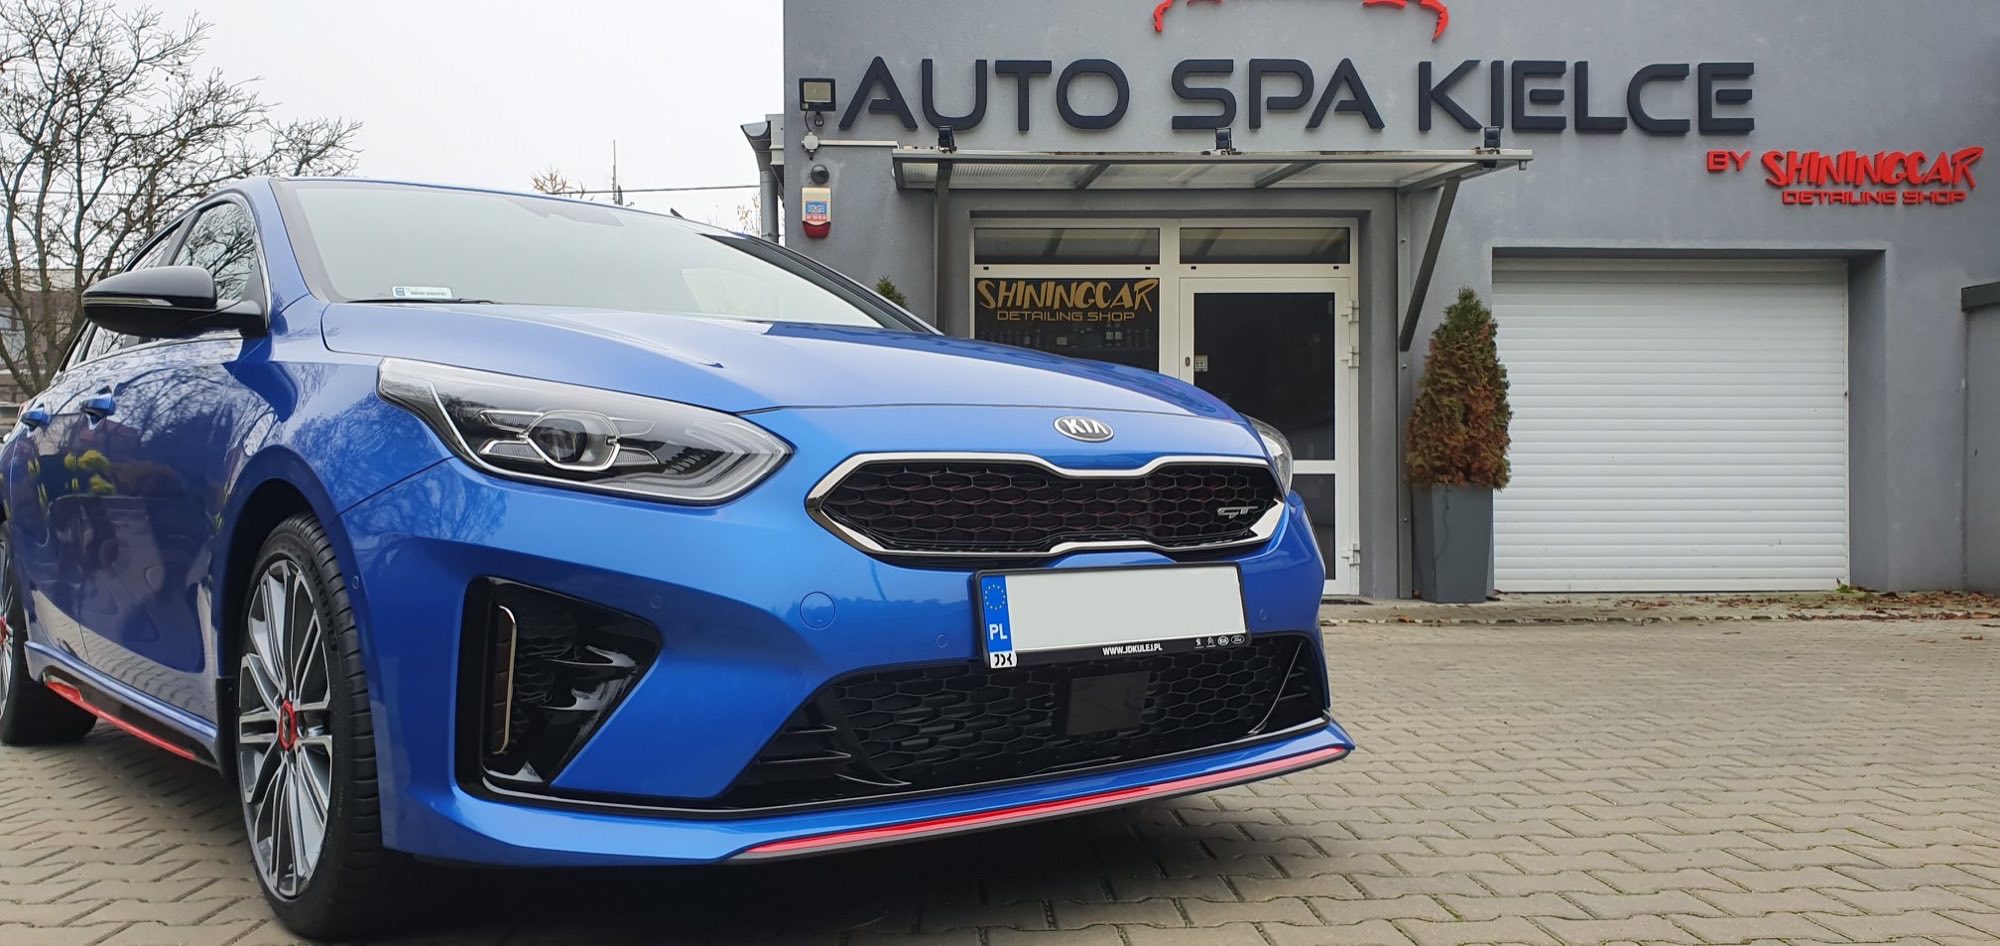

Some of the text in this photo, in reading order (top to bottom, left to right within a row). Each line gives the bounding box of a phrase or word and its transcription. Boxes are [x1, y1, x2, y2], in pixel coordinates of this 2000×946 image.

[838, 55, 1755, 135] AUTO SPA KIELCE
[1706, 146, 1985, 190] BY SHININGCAR
[1782, 190, 1967, 205] DETAILING SHOP
[976, 279, 1159, 313] SHININGCAR
[997, 311, 1136, 322] DETAILING SHOP
[1062, 418, 1109, 435] KIA
[989, 623, 1008, 640] PL
[1102, 642, 1163, 656] WWW.JDKULEJ.PL
